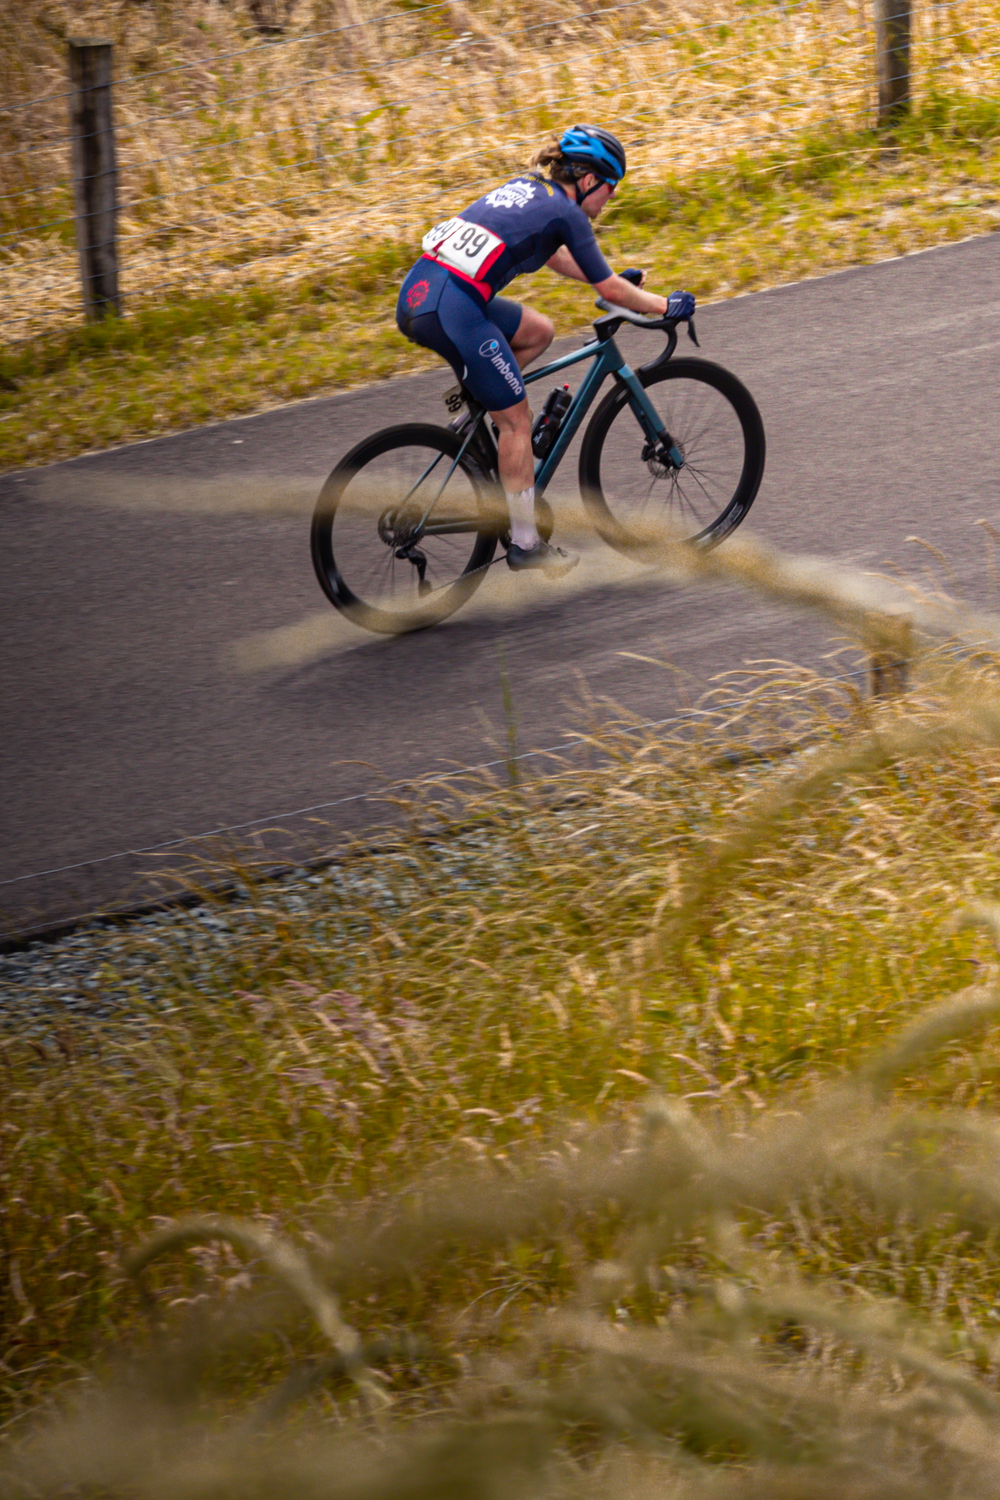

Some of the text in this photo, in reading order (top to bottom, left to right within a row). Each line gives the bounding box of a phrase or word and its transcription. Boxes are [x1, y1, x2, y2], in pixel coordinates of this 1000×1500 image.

[453, 227, 489, 258] 99
[490, 352, 523, 396] imbema
[445, 394, 462, 412] 99
